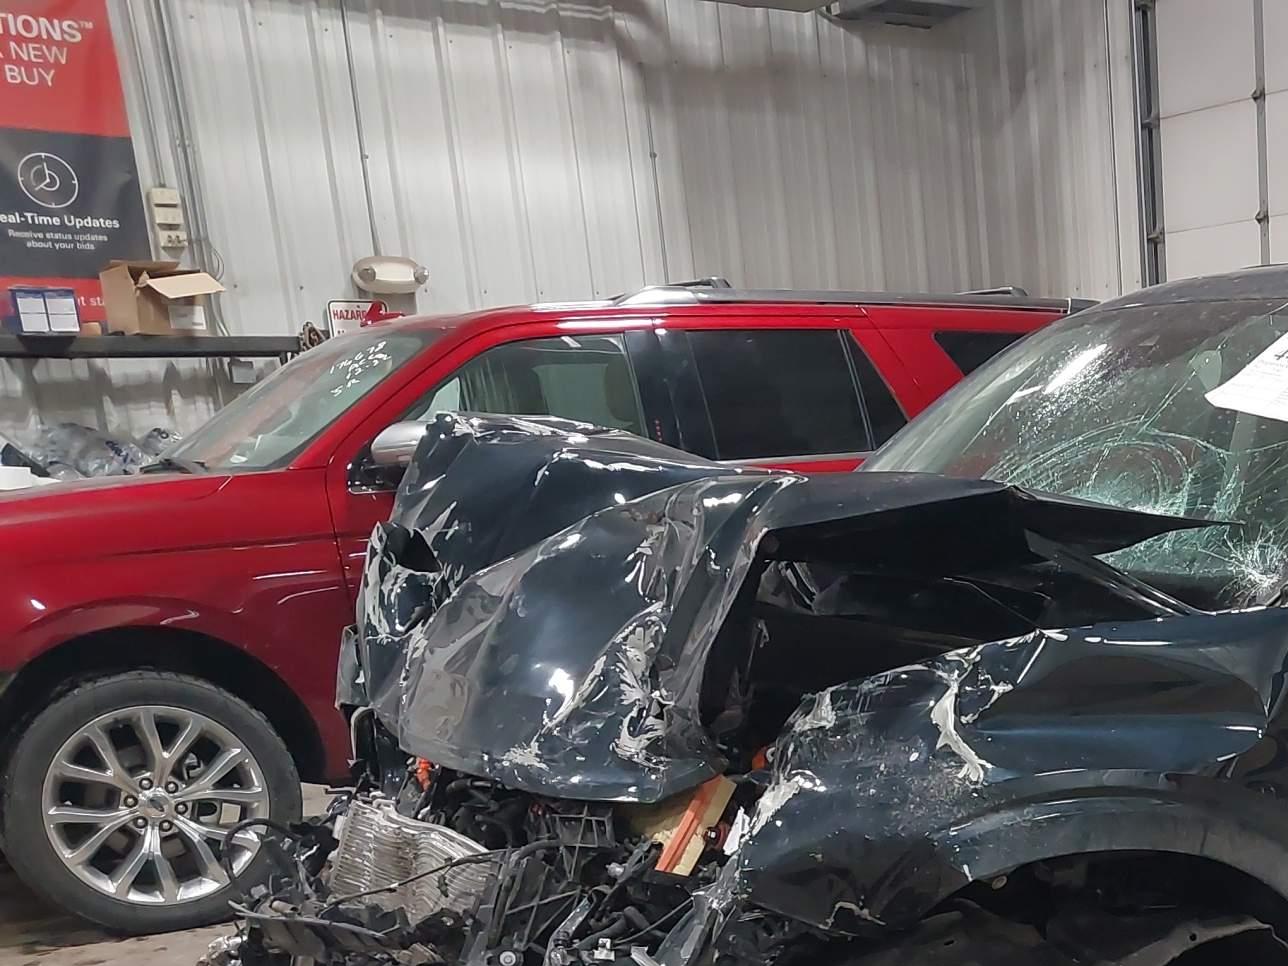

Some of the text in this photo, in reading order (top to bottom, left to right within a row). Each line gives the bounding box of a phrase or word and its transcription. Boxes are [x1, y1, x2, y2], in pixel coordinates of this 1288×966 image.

[9, 41, 67, 64] NEW
[4, 64, 54, 87] BUY
[63, 215, 120, 229] Updates
[45, 232, 72, 240] status
[73, 233, 108, 241] updates
[26, 240, 53, 249] about
[54, 242, 74, 250] your
